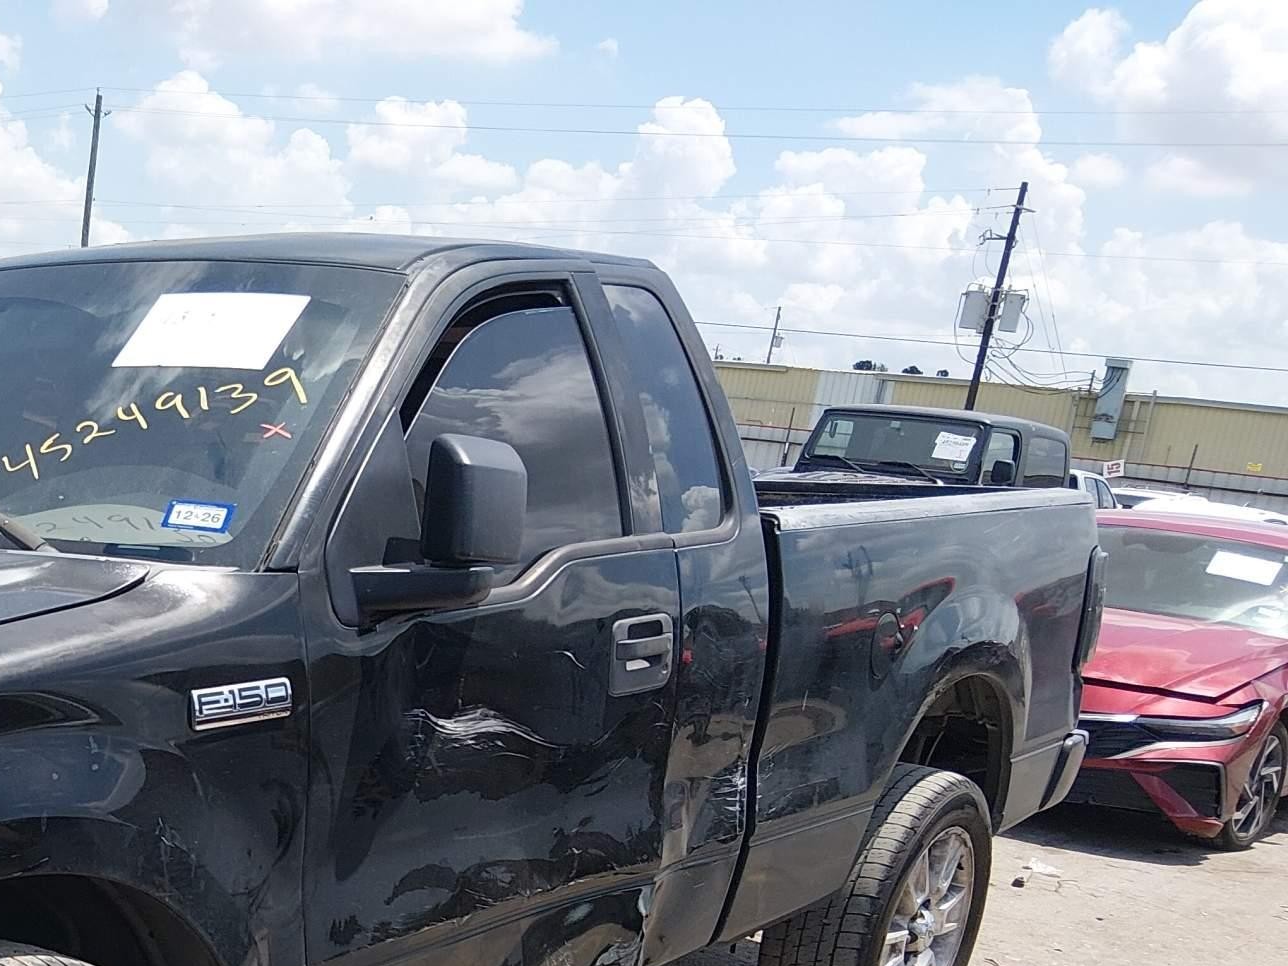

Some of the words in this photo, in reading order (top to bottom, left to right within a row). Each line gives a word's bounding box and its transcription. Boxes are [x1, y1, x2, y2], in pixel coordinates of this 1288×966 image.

[1, 367, 309, 480] 45249139
[1106, 462, 1121, 476] 15
[196, 682, 289, 716] F-150
